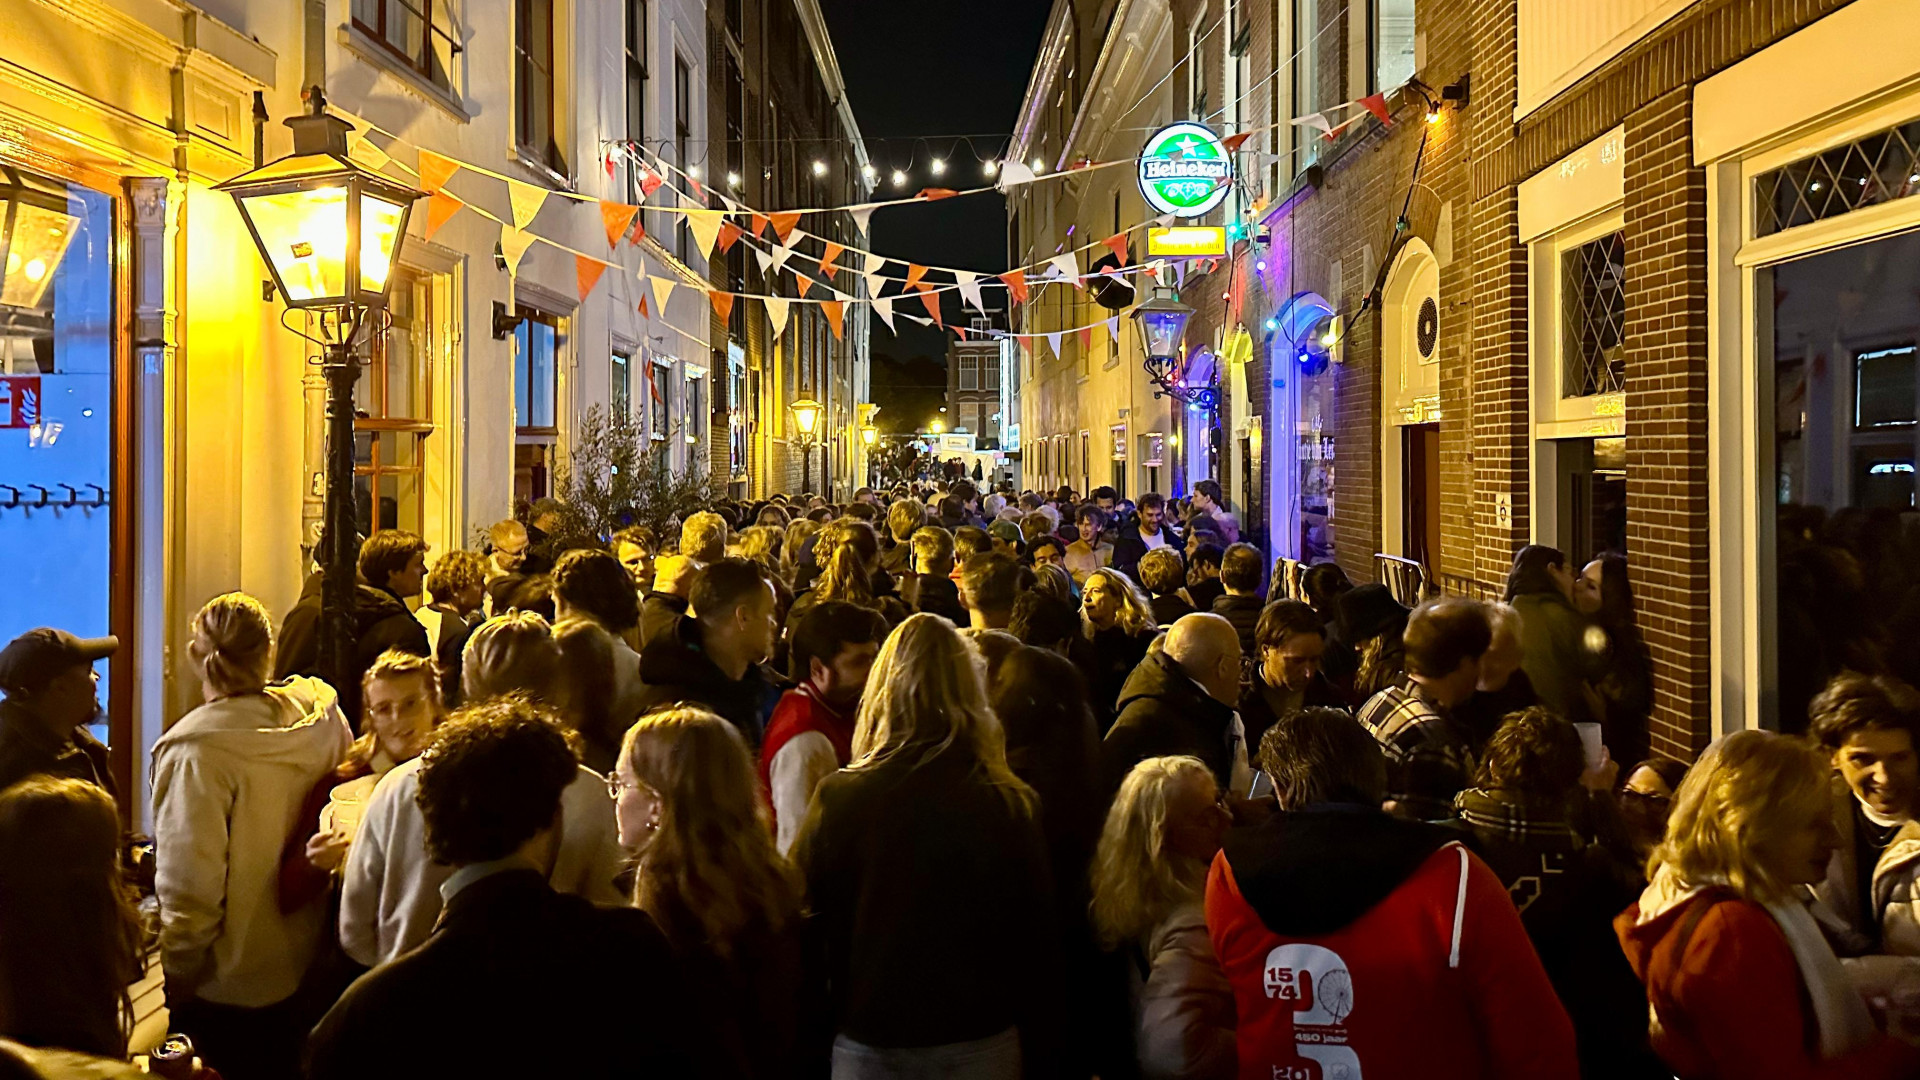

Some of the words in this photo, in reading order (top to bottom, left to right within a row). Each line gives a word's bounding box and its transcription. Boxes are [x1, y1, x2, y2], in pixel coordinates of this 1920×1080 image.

[1146, 161, 1226, 177] Heineken
[1267, 967, 1294, 983] 15
[1267, 984, 1298, 1000] 74
[1294, 1033, 1320, 1042] 450
[1323, 1033, 1348, 1044] jaar
